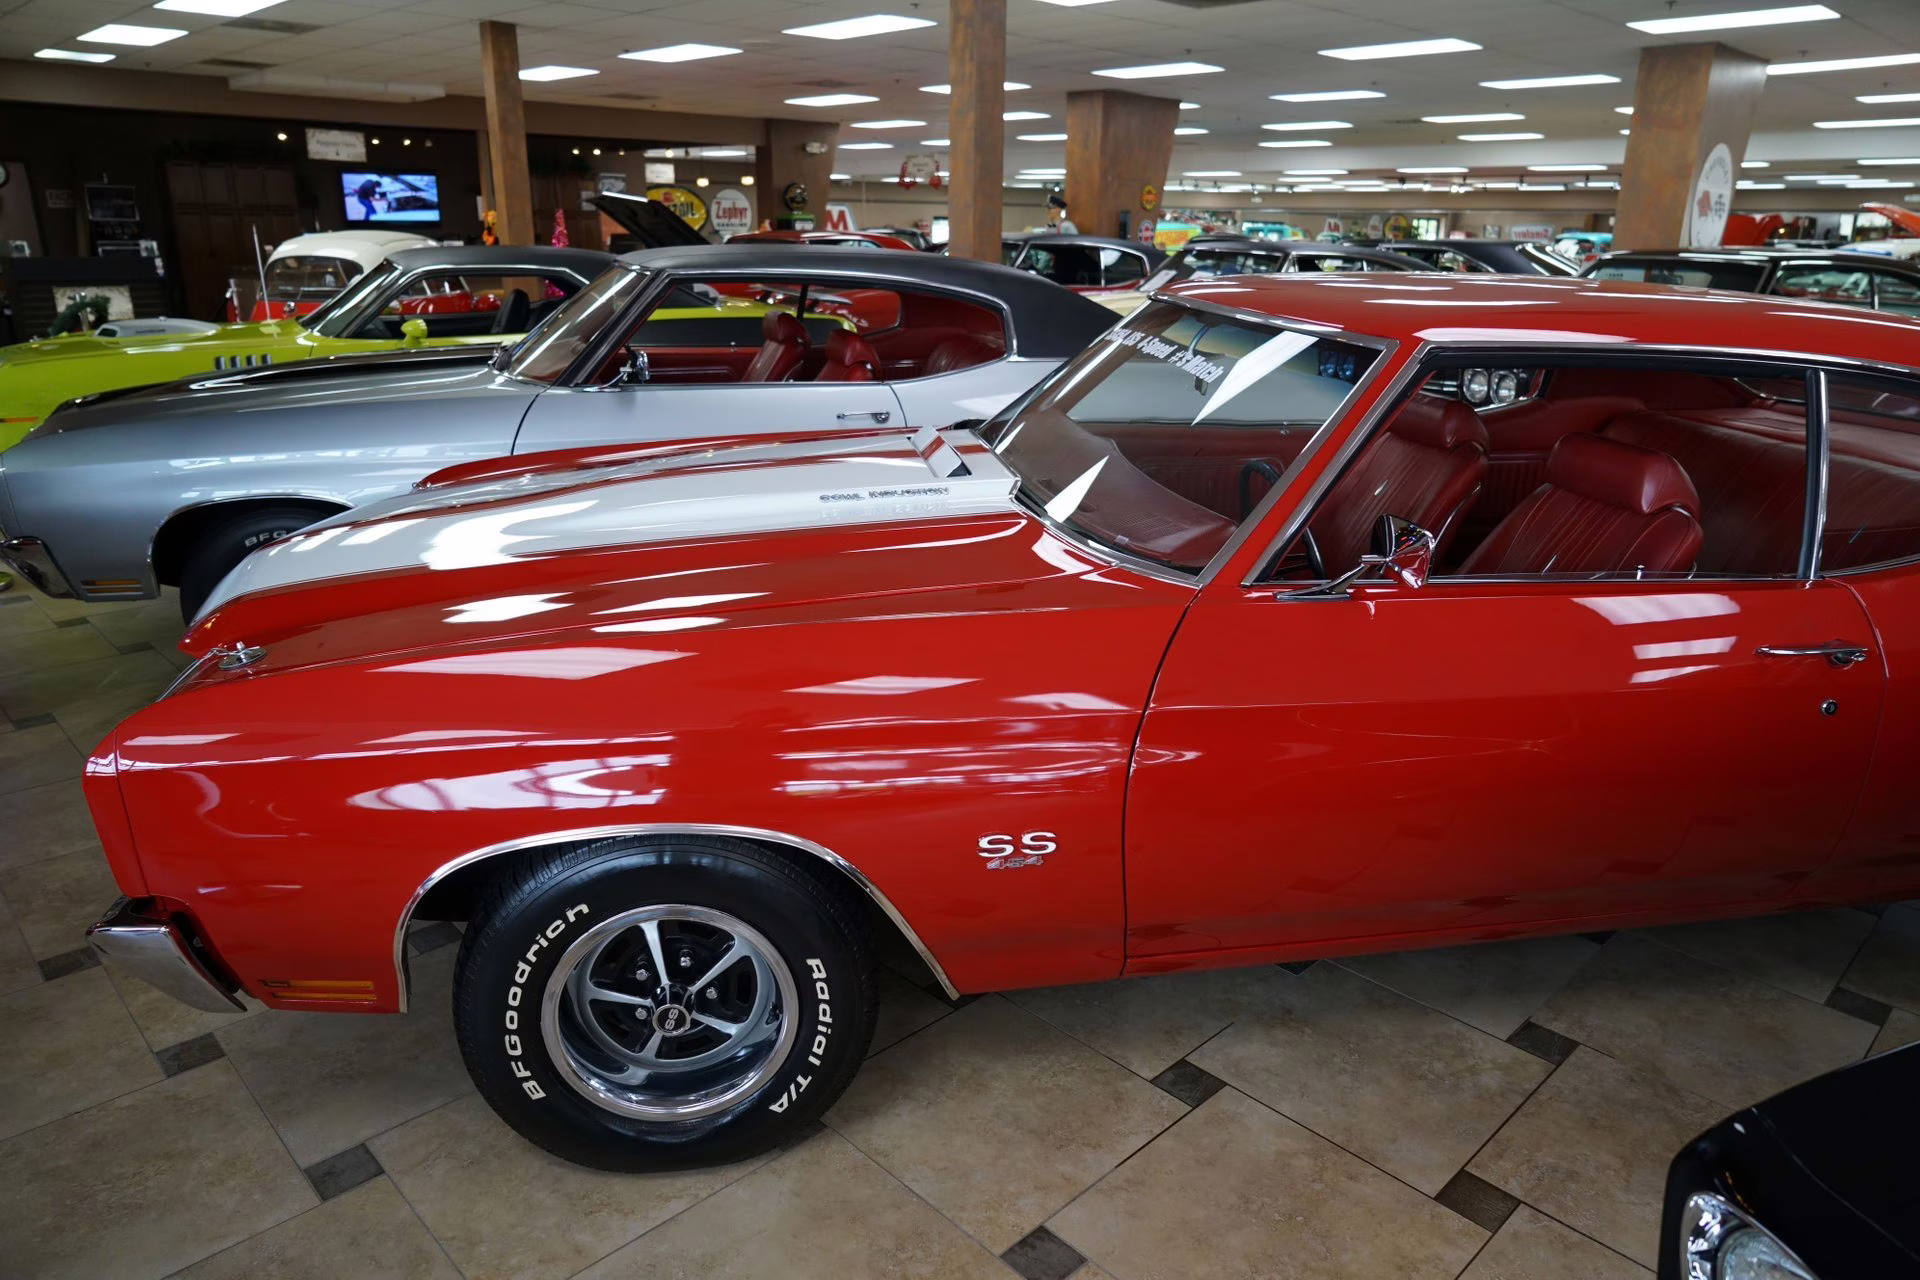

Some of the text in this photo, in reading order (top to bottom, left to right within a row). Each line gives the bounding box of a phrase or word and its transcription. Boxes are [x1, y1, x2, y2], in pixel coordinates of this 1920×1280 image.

[715, 201, 748, 221] Zephyr
[1136, 335, 1178, 359] 4-Speed
[1182, 355, 1224, 383] Match
[819, 486, 950, 503] COWL INDUCTION
[244, 530, 287, 547] BFG
[978, 831, 1057, 858] SS
[986, 855, 1044, 869] 454
[505, 903, 590, 1101] BFGoodrich
[664, 1008, 680, 1031] SS
[769, 958, 835, 1114] Radial T/A
